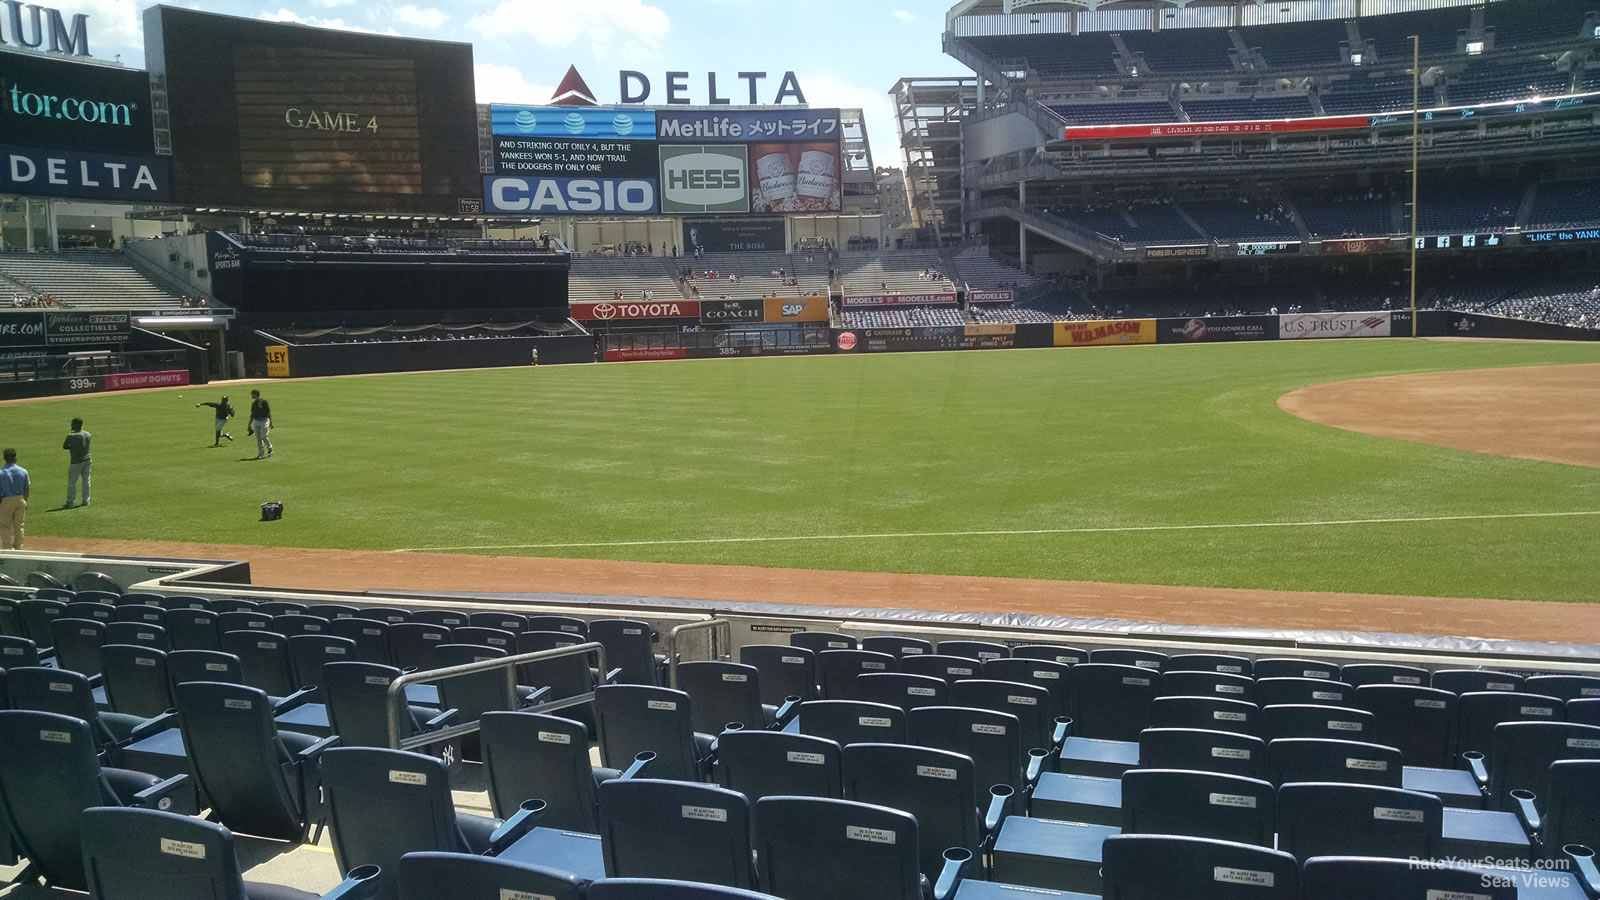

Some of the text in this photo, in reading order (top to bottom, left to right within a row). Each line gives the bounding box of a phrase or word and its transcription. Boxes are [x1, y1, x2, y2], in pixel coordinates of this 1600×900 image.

[0, 0, 92, 57] UM
[619, 69, 808, 105] DELTA
[285, 108, 378, 133] GAME 4
[660, 117, 743, 138] MetLife
[748, 118, 838, 136] メットライフ
[571, 143, 590, 151] ONLY
[592, 144, 599, 152] 4,
[500, 152, 533, 160] YANKEES
[554, 153, 568, 161] 5-1,
[517, 162, 552, 171] DODGERS
[554, 163, 563, 171] BY
[9, 154, 159, 191] DELTA
[668, 168, 742, 190] HESS
[762, 181, 793, 192] Budweis
[491, 178, 653, 213] CASIO
[1559, 231, 1573, 240] the
[1575, 230, 1600, 239] YANK
[1164, 248, 1207, 256] BUSINESS
[215, 260, 240, 269] SPORTS BAR
[846, 295, 954, 305] MODELL'S MODELLS.com
[618, 303, 681, 317] TOYOTA
[706, 310, 759, 319] COACH
[781, 304, 804, 315] SAP
[60, 324, 118, 332] COLLECTIBLES
[1284, 319, 1357, 333] U.S. TRUST
[49, 335, 129, 343] STEINERSPORTS.COM
[120, 374, 181, 385] DUNKIN' DONUTS
